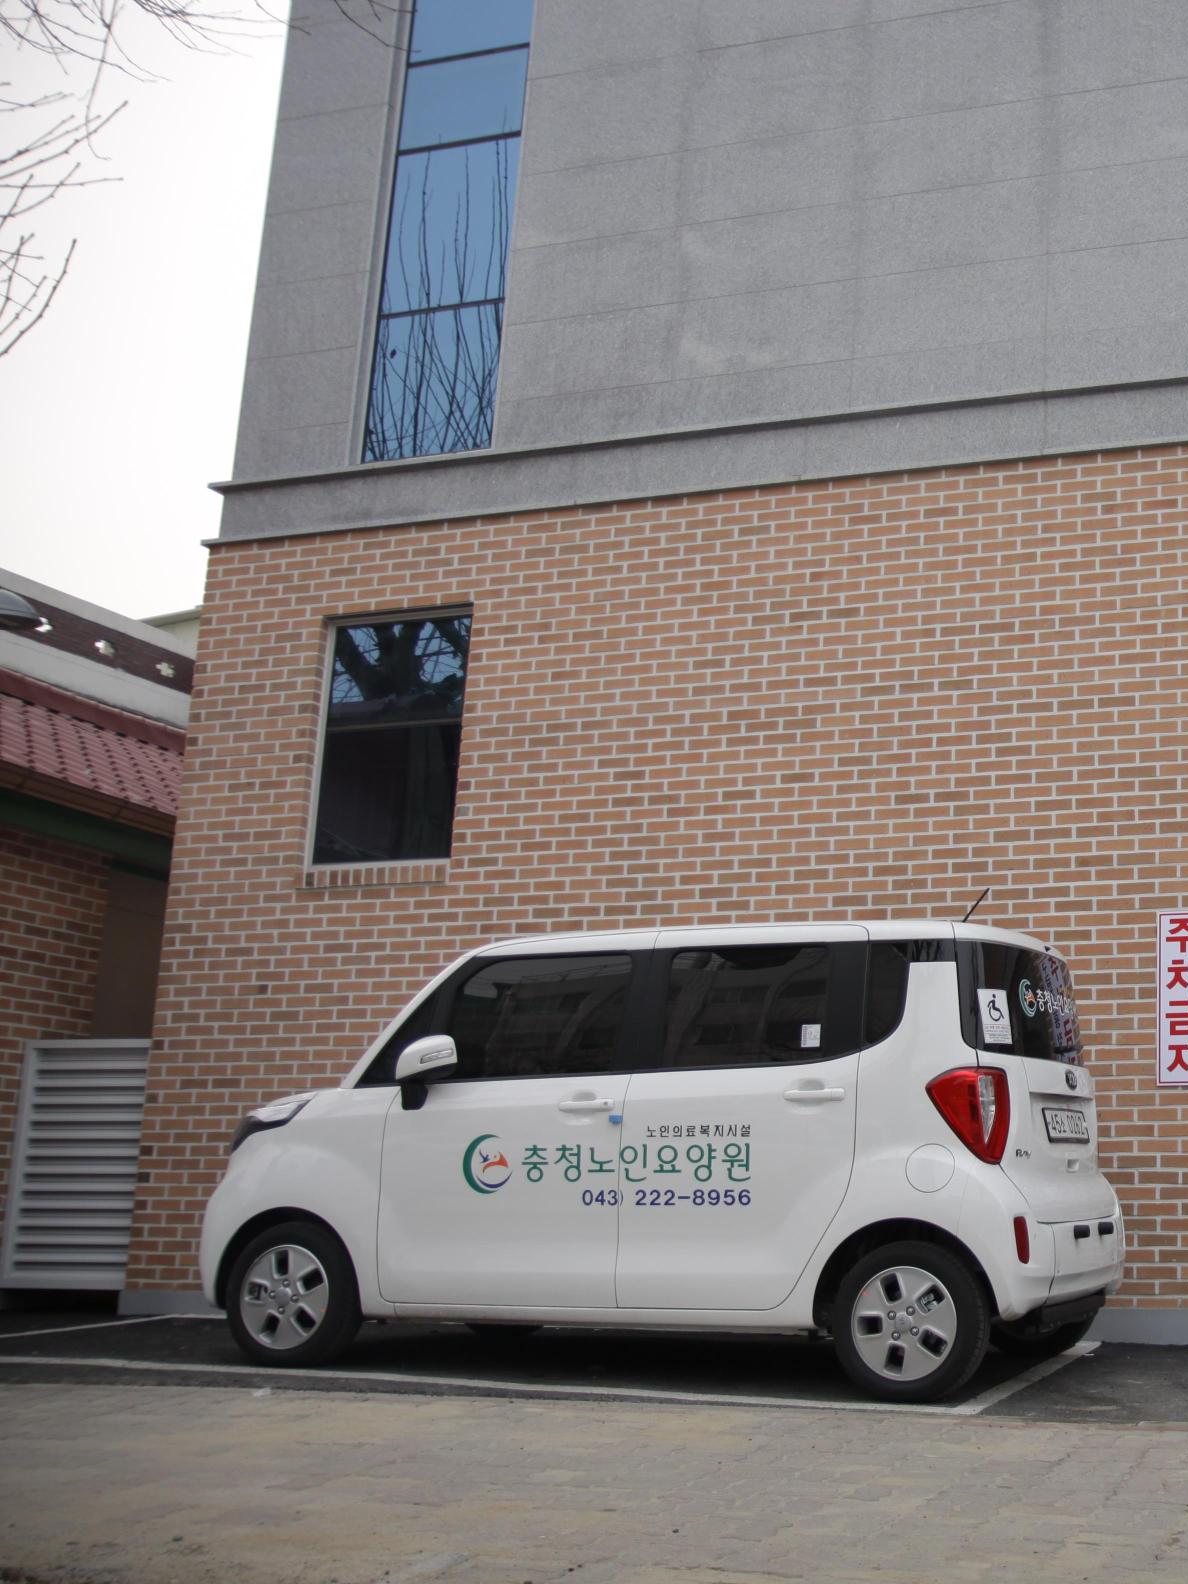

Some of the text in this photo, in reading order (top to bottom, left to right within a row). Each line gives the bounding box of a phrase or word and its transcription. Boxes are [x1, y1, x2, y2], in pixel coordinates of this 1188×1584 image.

[646, 1124, 751, 1138] 노인의료복지시설
[521, 1143, 751, 1183] 충청노인요양원
[635, 1189, 751, 1206] 222-8956
